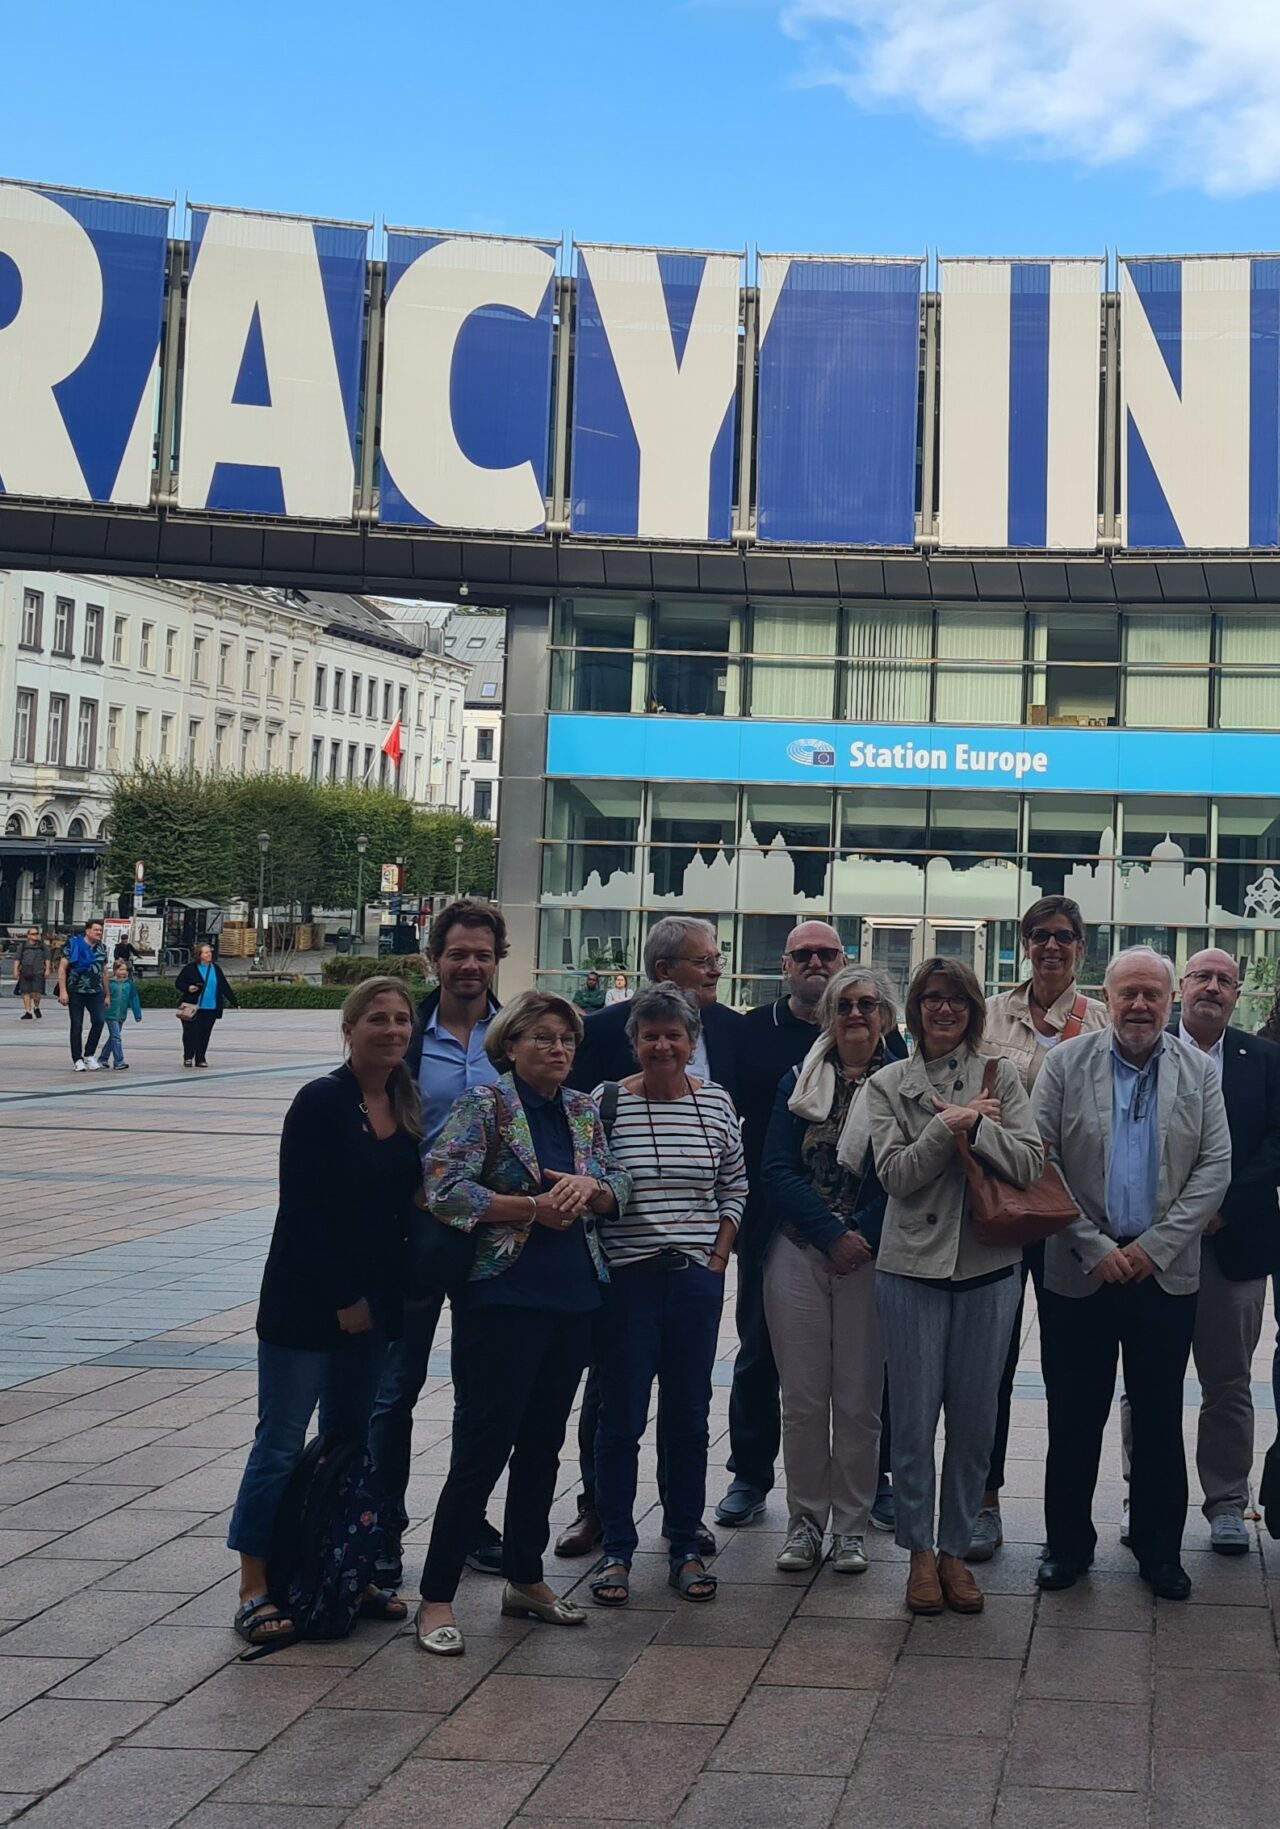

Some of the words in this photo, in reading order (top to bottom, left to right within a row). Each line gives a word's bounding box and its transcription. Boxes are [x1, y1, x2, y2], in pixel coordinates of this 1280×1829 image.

[939, 258, 1251, 549] IN
[850, 741, 947, 769] Station
[955, 744, 1048, 779] Europe
